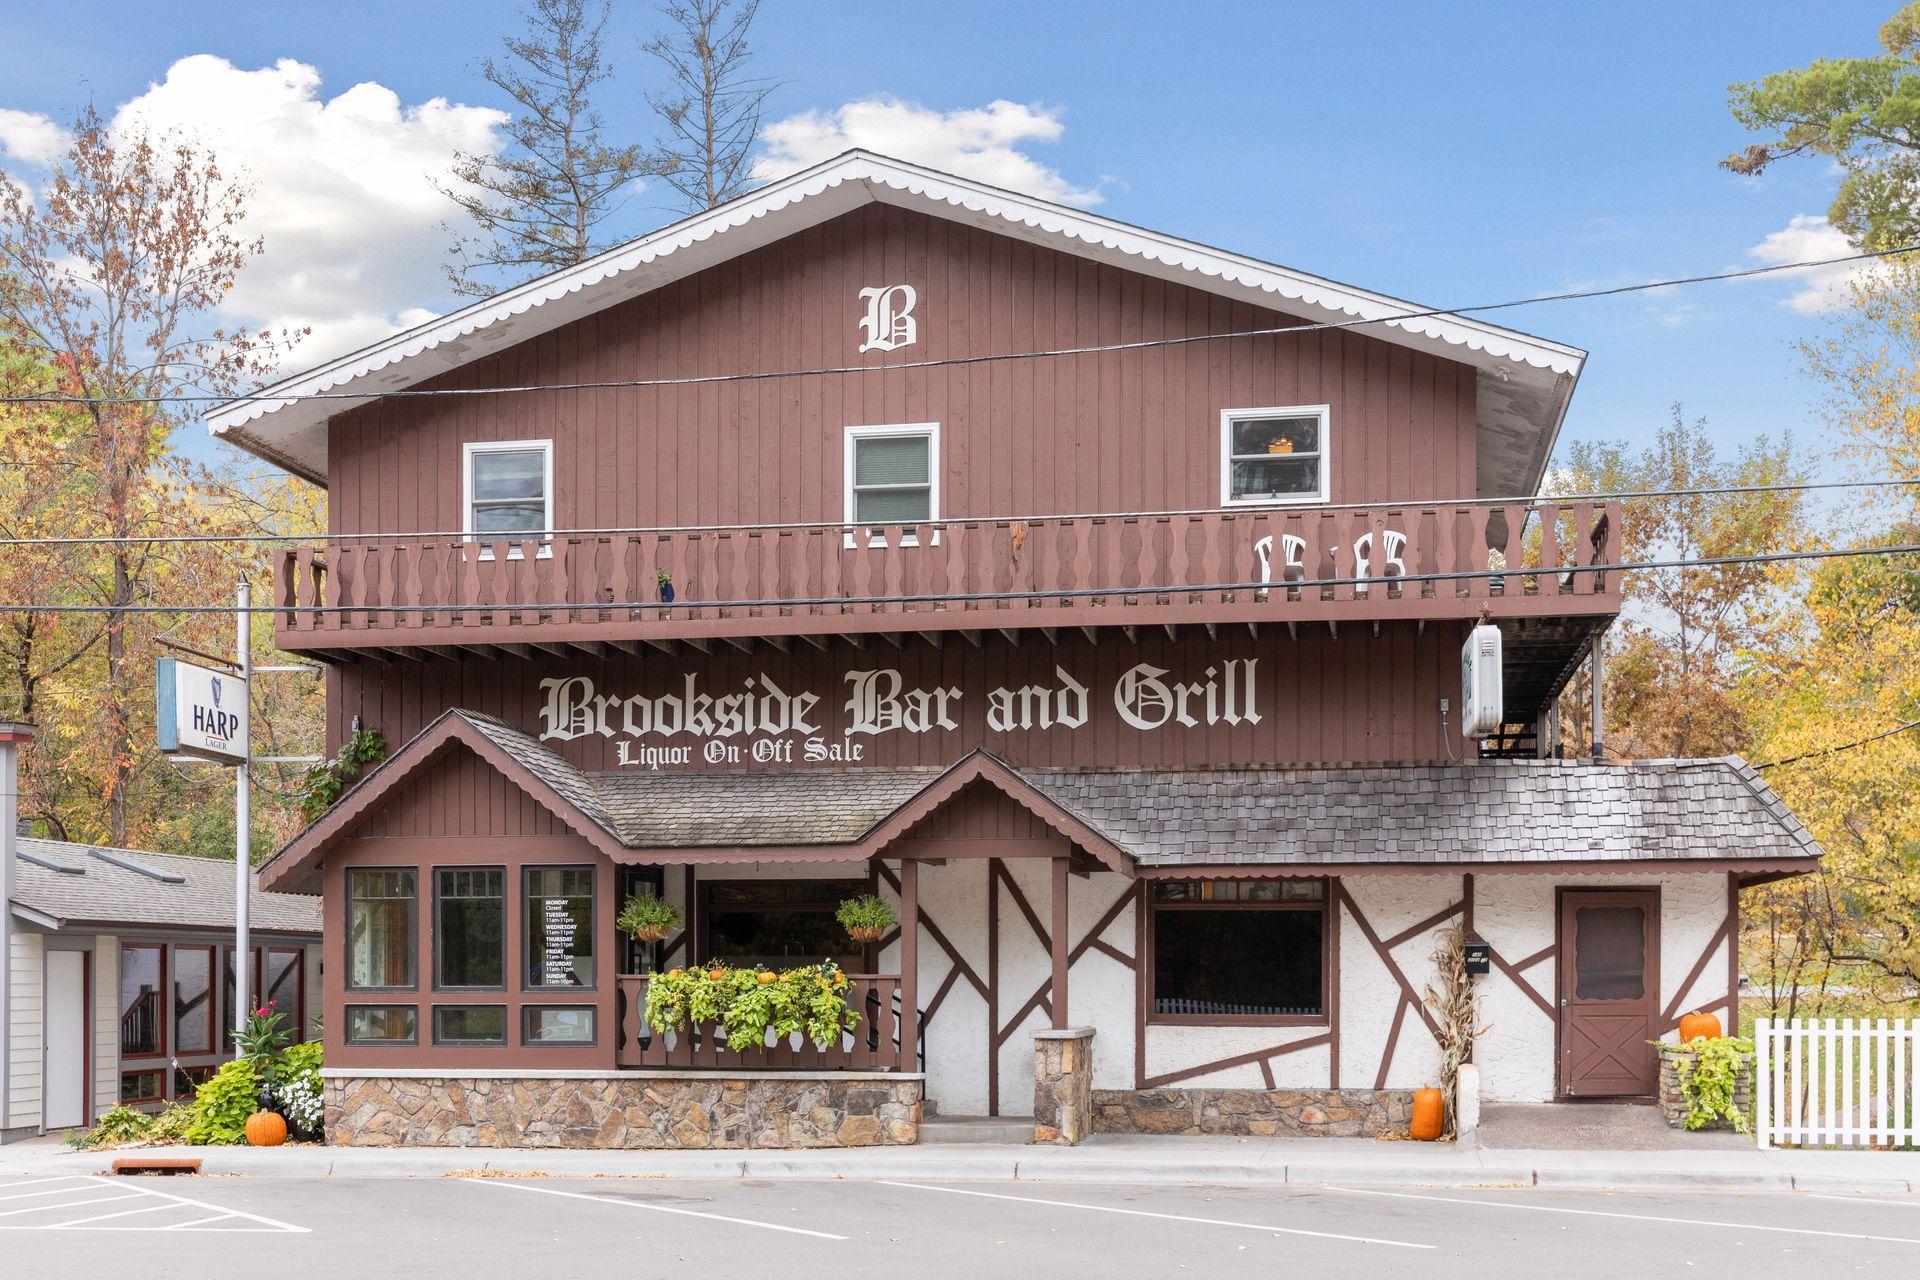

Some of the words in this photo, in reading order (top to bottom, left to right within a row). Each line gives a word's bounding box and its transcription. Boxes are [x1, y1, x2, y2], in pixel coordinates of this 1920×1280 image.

[858, 284, 917, 353] B
[538, 671, 822, 742] Brookside
[843, 668, 964, 736] Bar
[986, 664, 1090, 732] and
[1113, 657, 1263, 731] Grill
[193, 704, 239, 741] HARP
[205, 738, 228, 751] LAGER
[615, 740, 692, 771] Liquor
[803, 736, 864, 763] Sale
